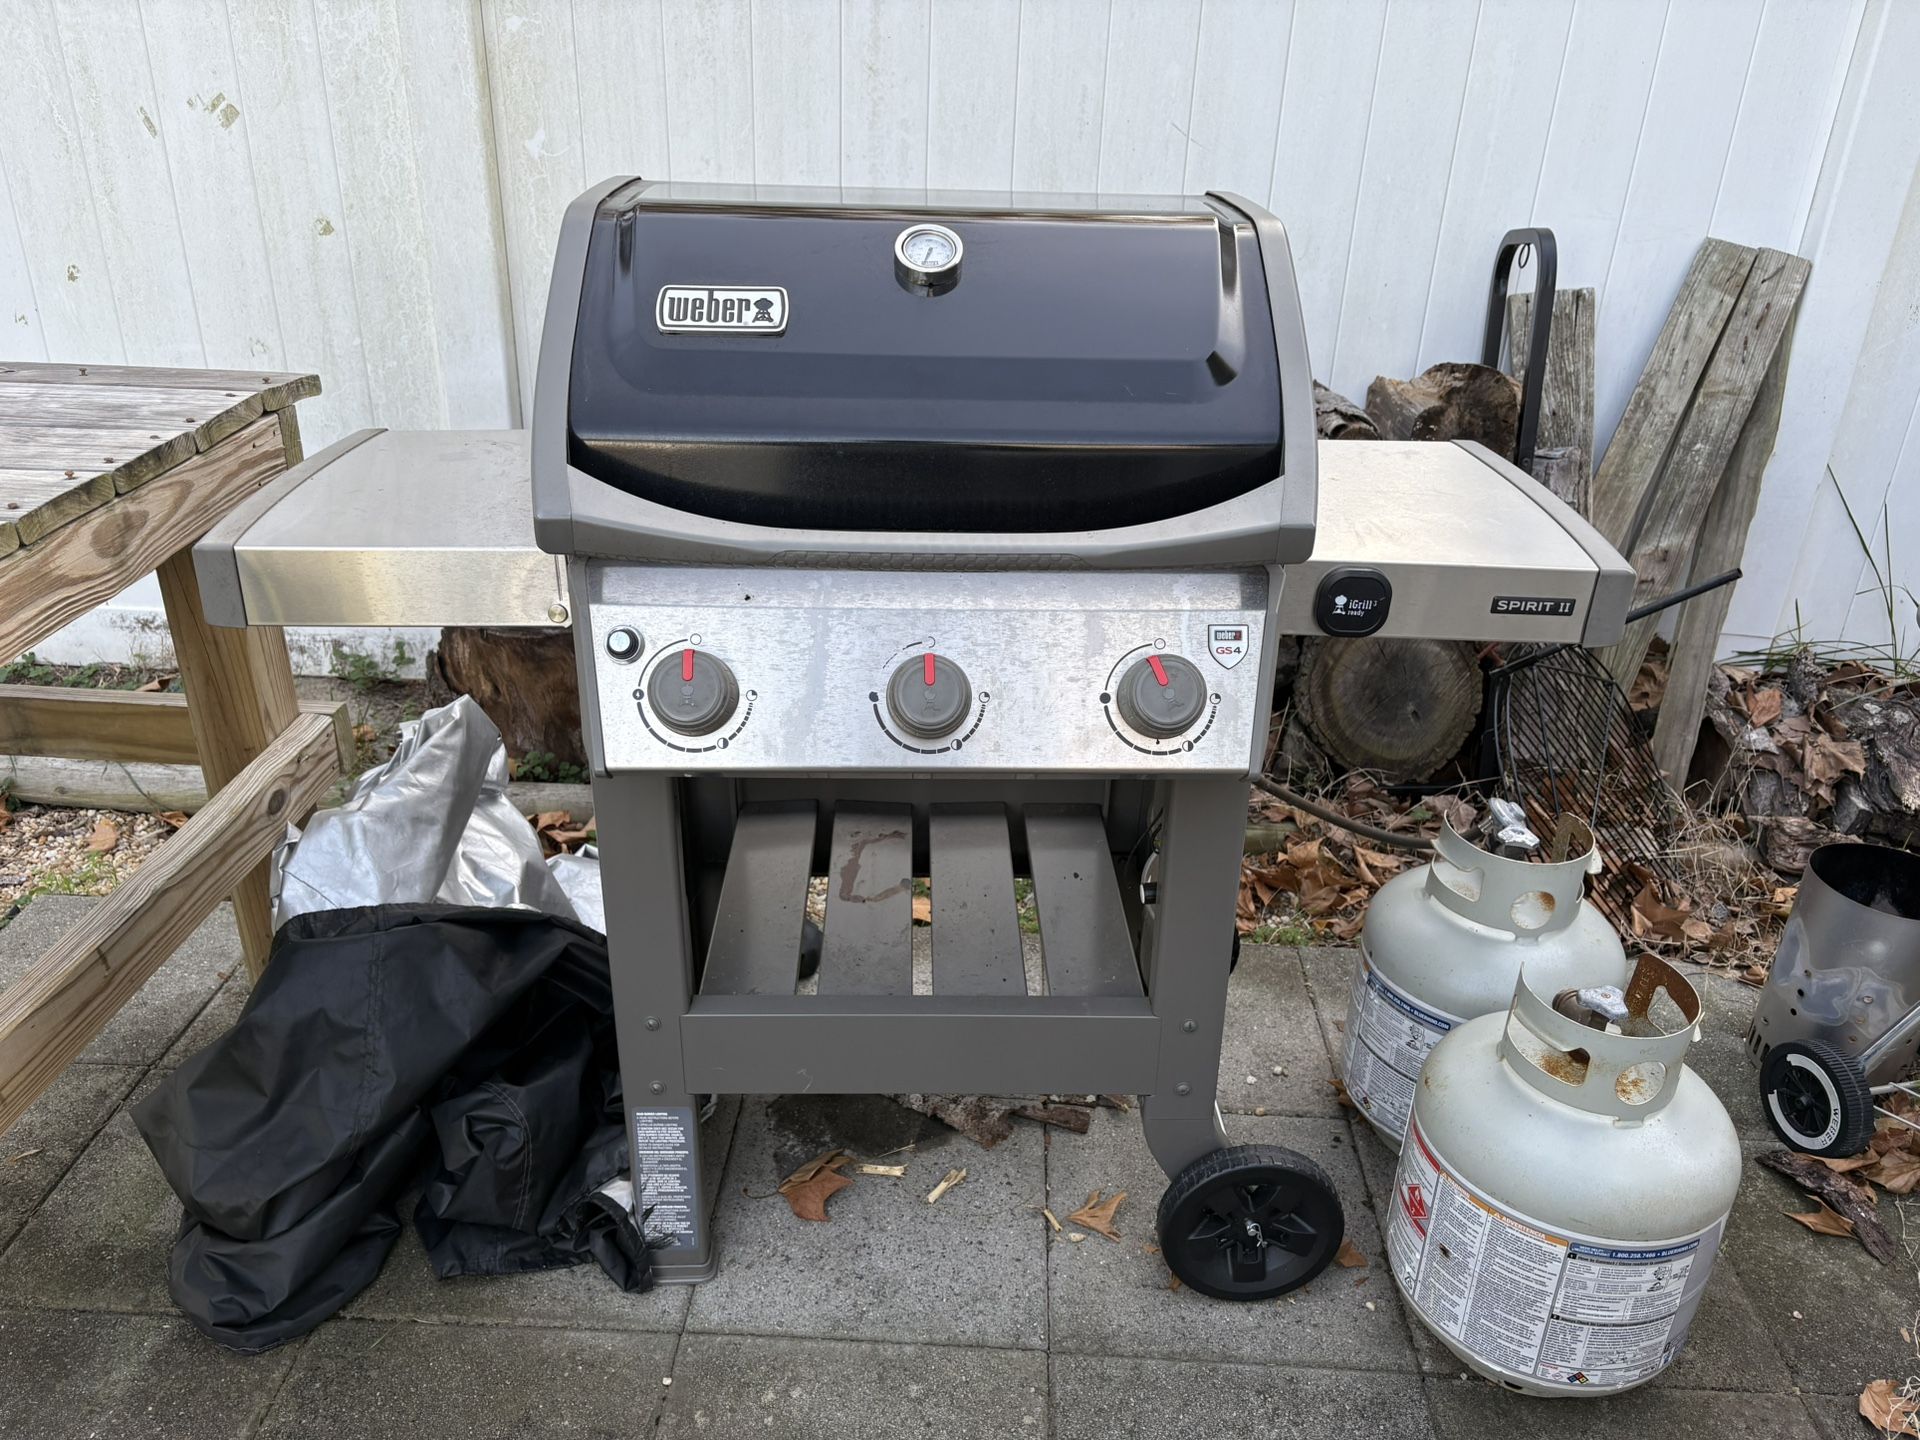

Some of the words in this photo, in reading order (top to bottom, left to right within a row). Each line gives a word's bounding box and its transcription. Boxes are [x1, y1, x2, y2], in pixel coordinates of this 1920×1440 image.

[667, 289, 751, 323] weber
[1496, 600, 1555, 612] SPIRIT
[1558, 602, 1571, 613] II
[1216, 630, 1236, 640] weber
[1215, 646, 1242, 655] GS4
[1821, 1108, 1839, 1146] WEBER
[1502, 1215, 1546, 1239] ADVERTENCIA
